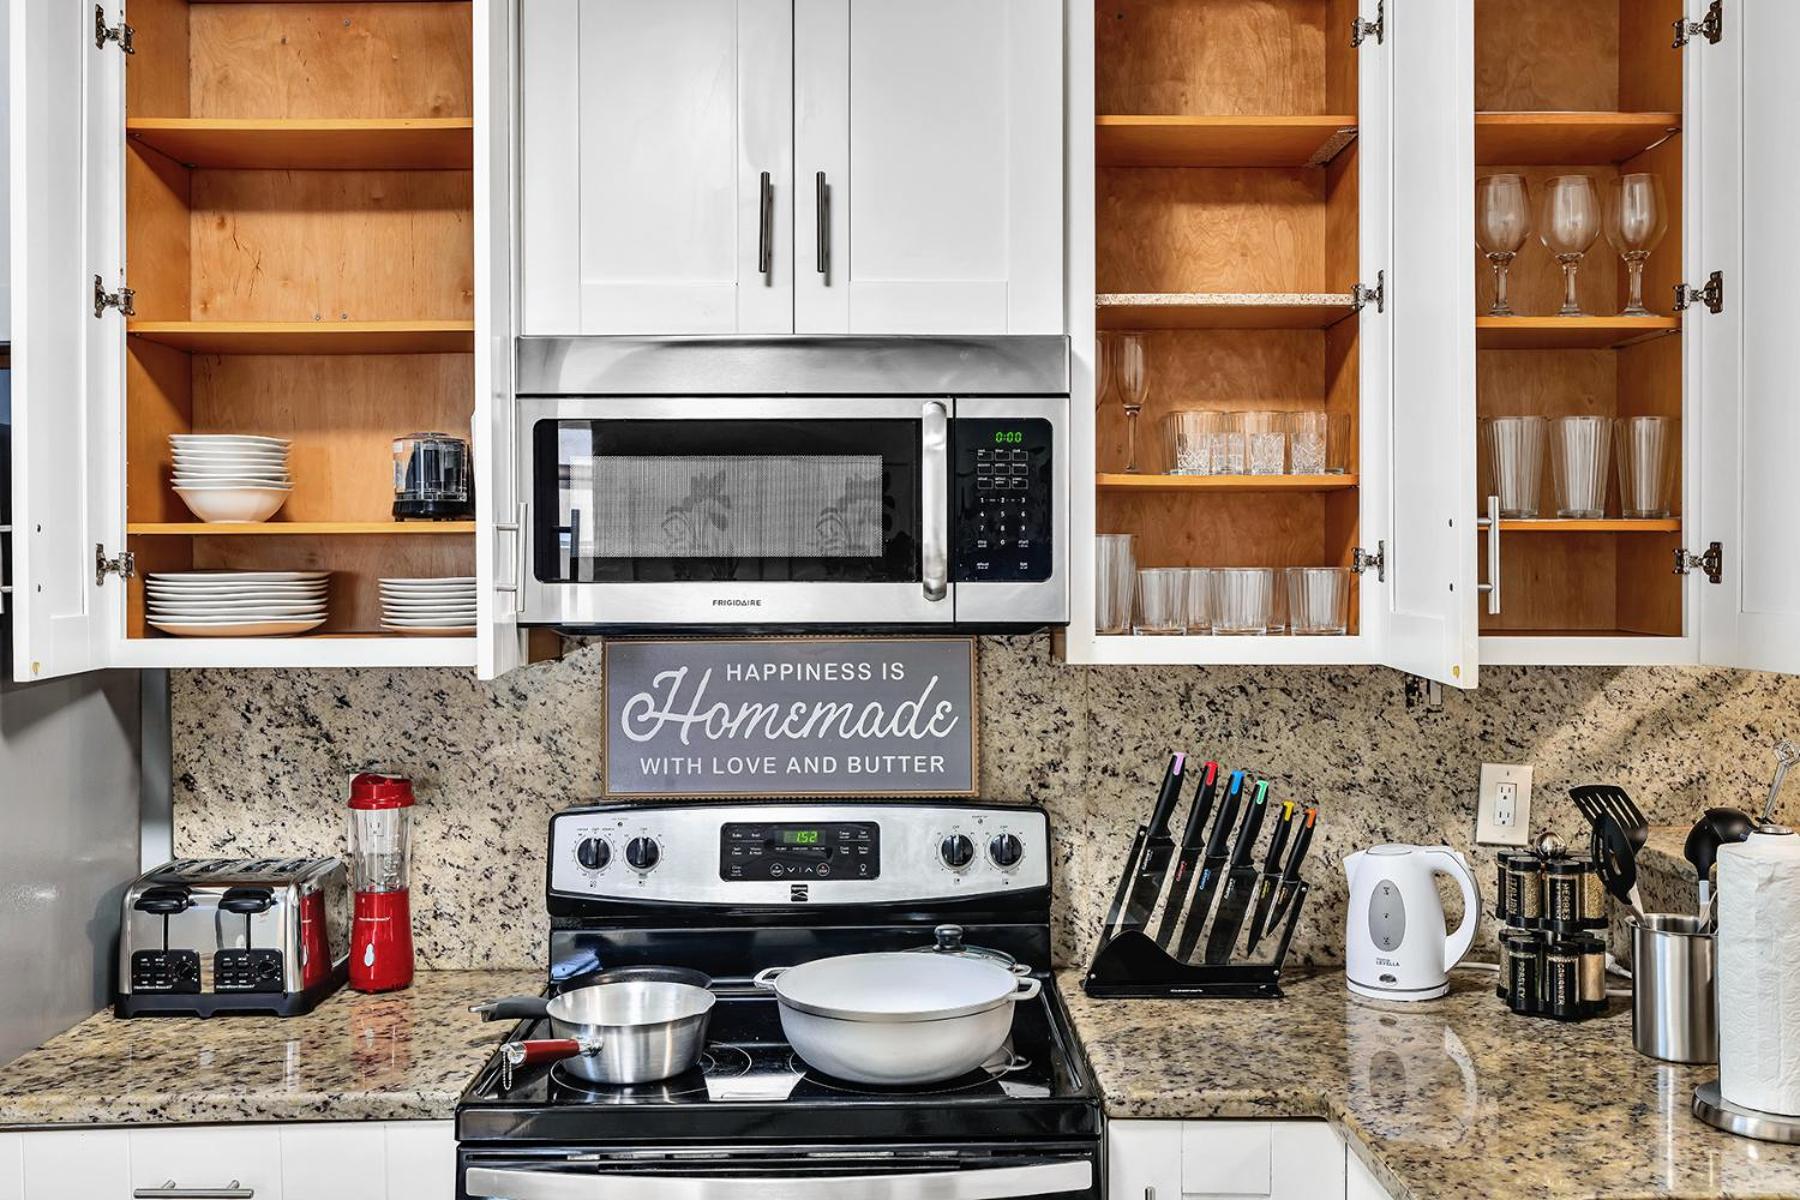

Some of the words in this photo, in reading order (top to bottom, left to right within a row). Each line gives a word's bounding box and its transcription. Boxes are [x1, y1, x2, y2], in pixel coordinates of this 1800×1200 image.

[995, 431, 1022, 443] 0:00
[726, 663, 872, 681] HAPPINESS
[882, 662, 905, 680] IS
[620, 666, 959, 746] Homemade
[640, 757, 702, 775] WITH
[713, 757, 777, 775] LOVE
[786, 757, 838, 774] AND
[847, 755, 945, 774] BUTTER
